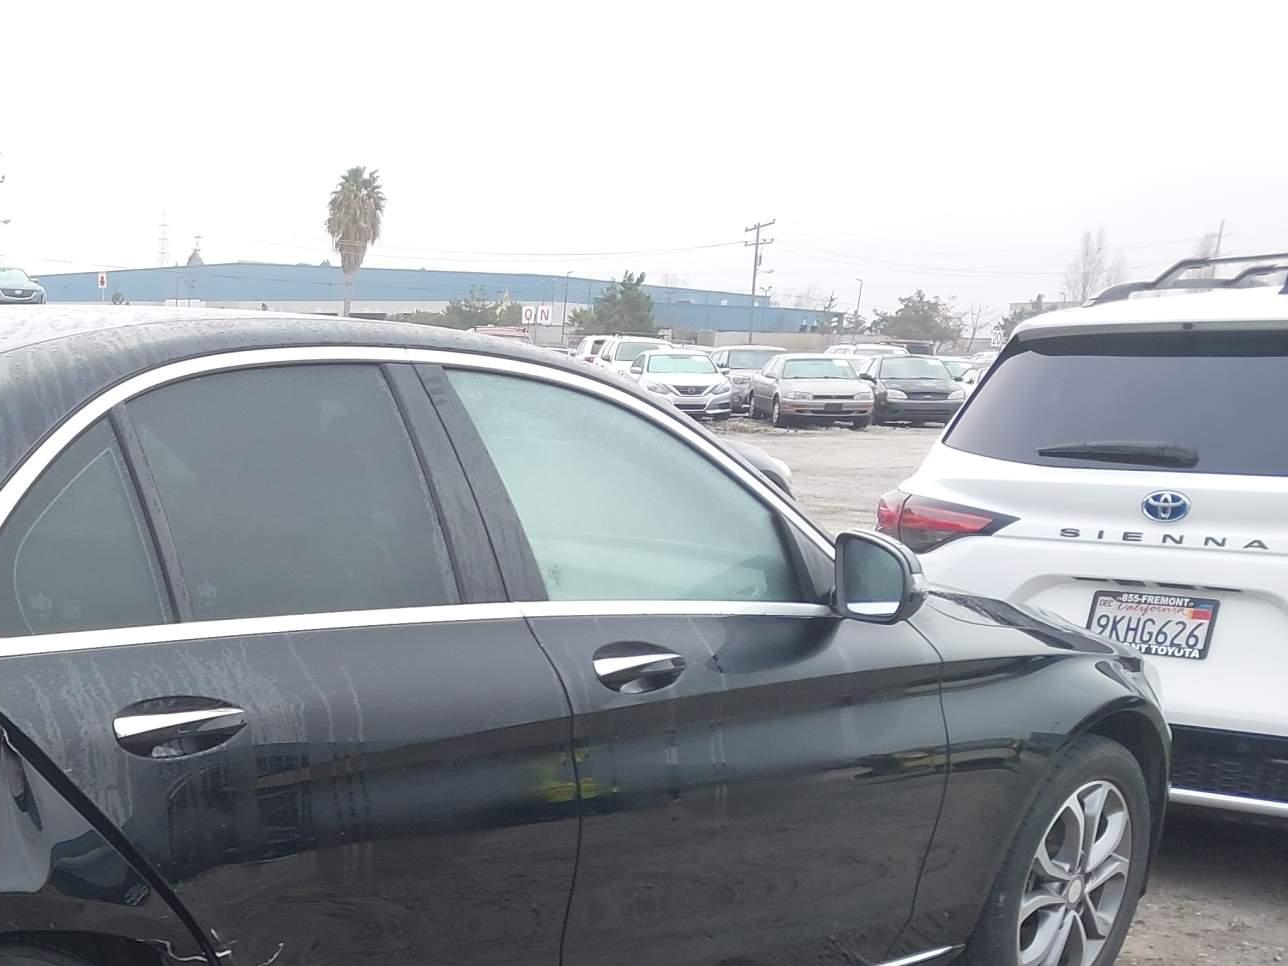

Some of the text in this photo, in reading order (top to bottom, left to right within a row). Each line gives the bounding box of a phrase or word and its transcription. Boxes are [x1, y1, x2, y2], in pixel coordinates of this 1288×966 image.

[1059, 528, 1269, 550] SIENNA
[1099, 599, 1114, 607] DEC
[1122, 593, 1190, 607] 855-FREMONT
[1096, 614, 1205, 649] 9KHG626
